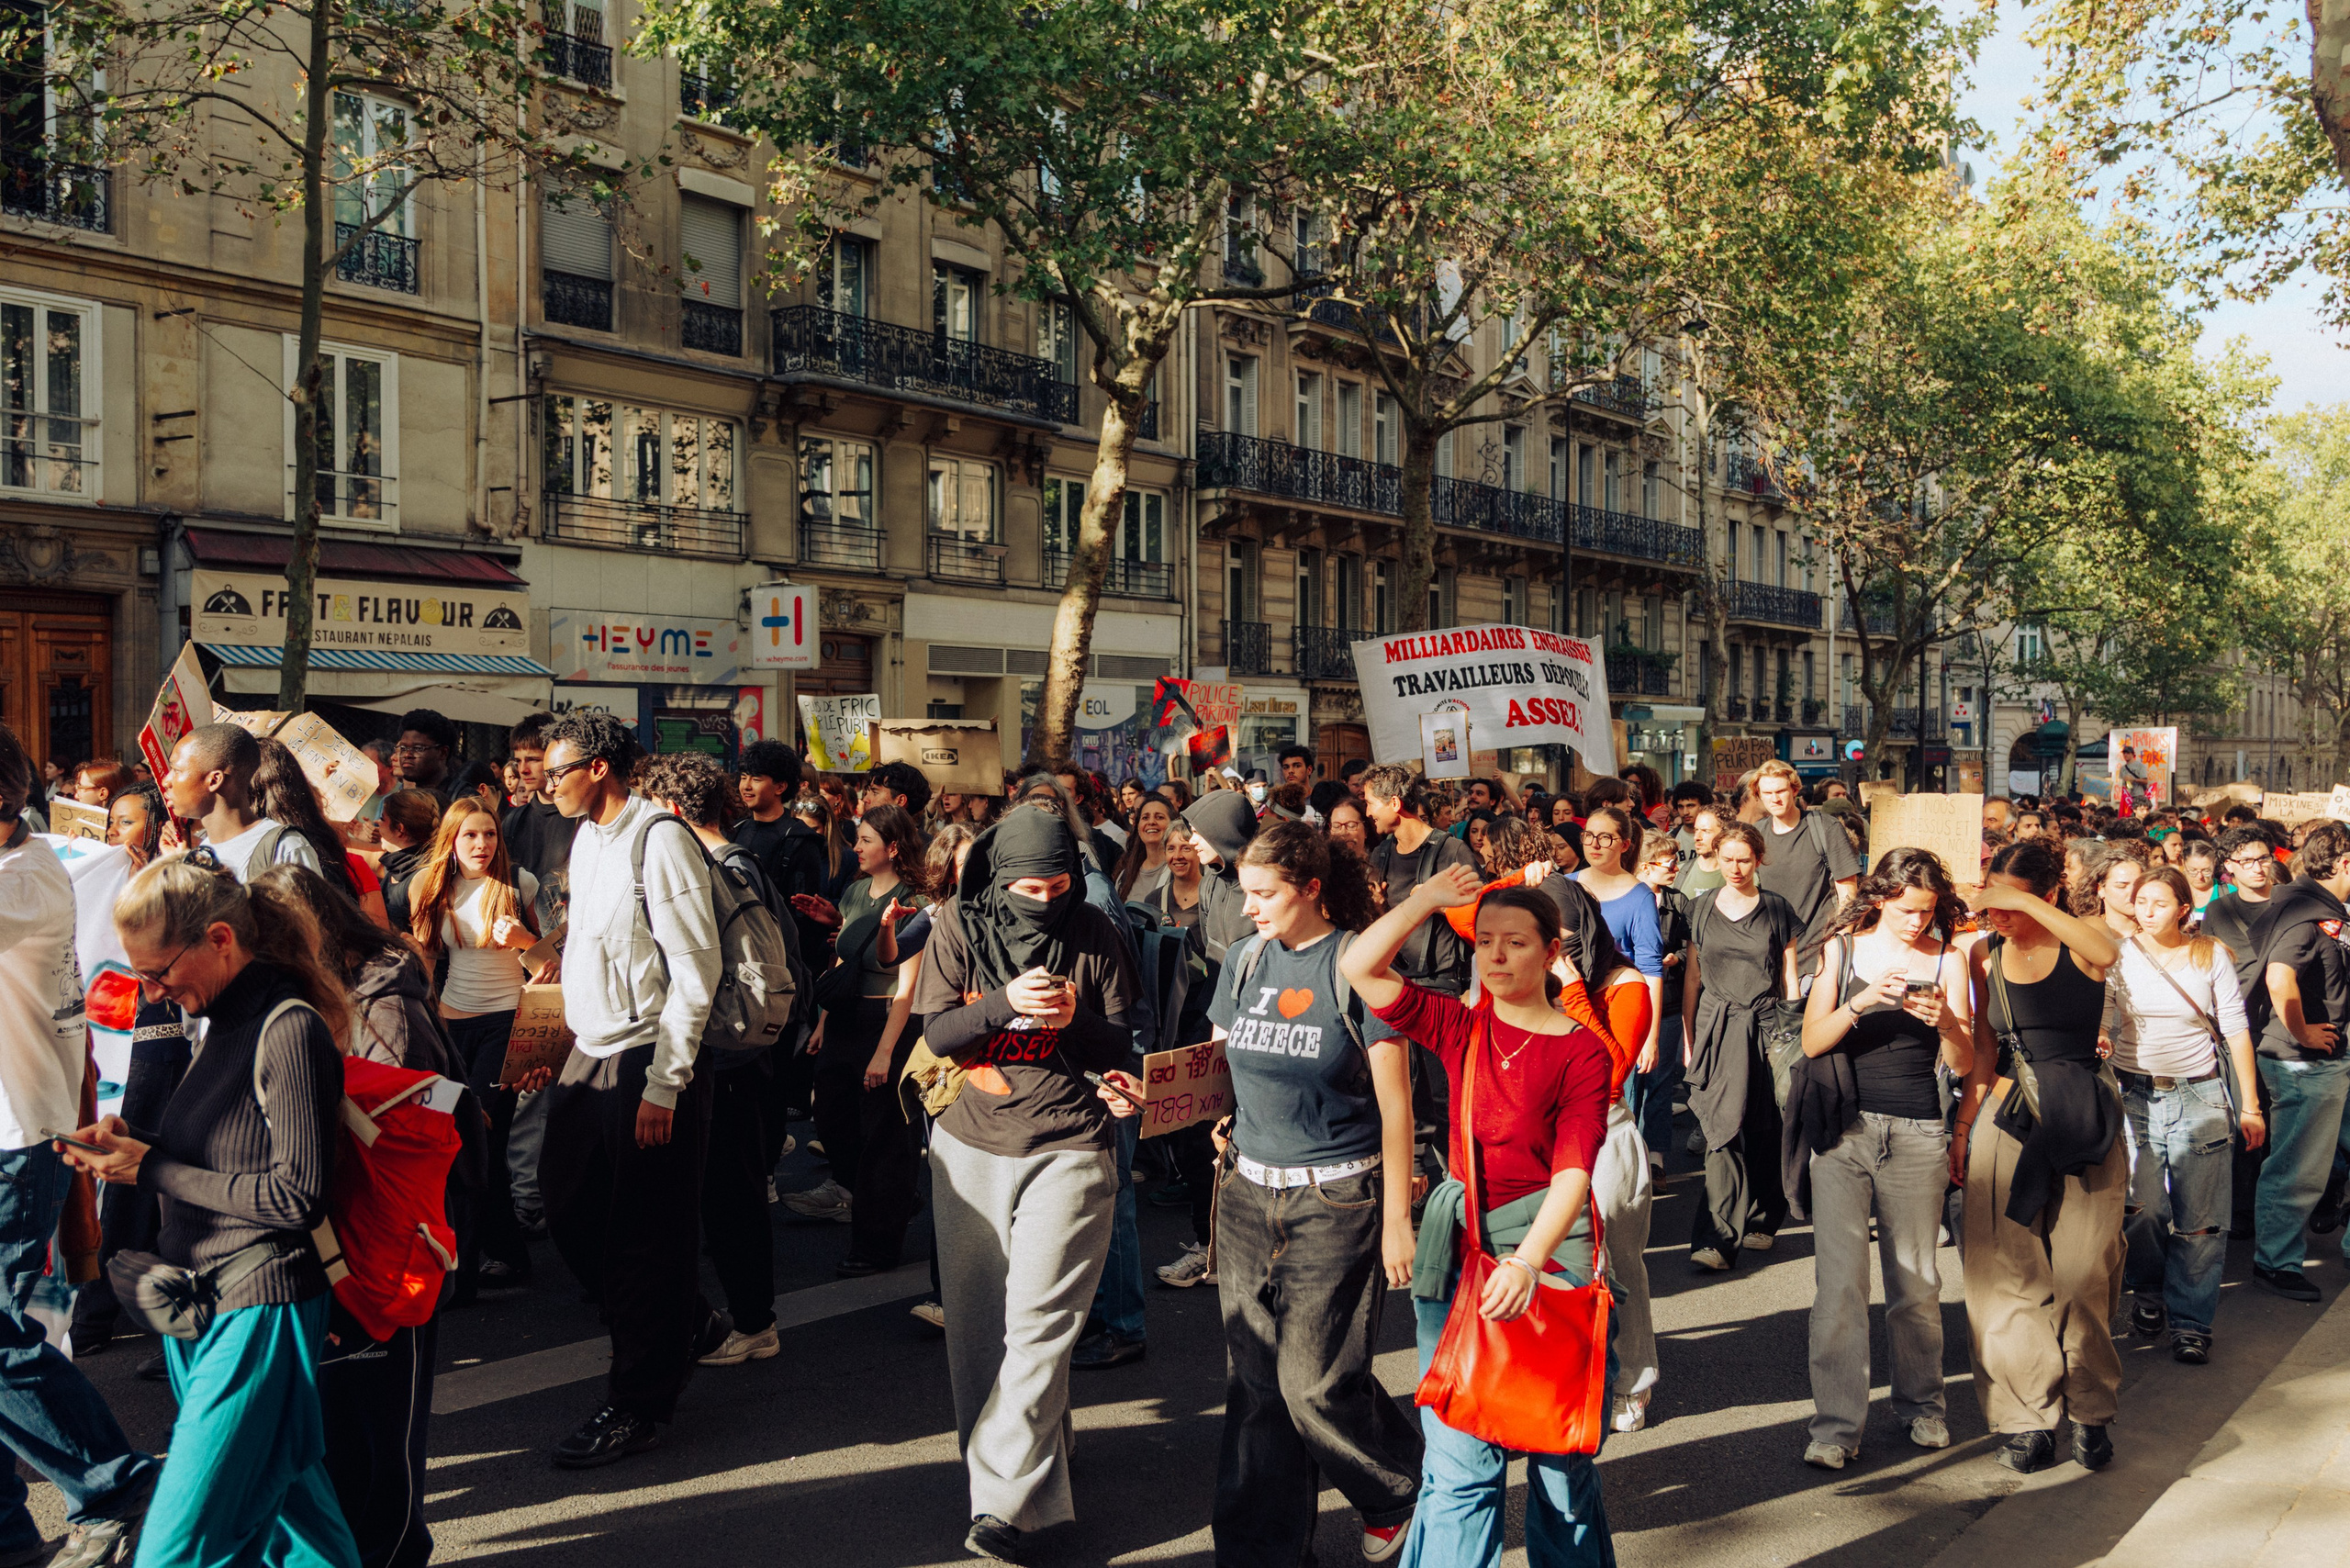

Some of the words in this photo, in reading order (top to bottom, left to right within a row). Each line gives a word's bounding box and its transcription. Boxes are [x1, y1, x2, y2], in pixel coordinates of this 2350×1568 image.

[312, 630, 375, 644] STAURANT
[377, 631, 432, 647] NÉPALAIS
[582, 624, 713, 657] HEYME
[1383, 627, 1526, 664] MILLIARDAIRES
[1529, 629, 1594, 666] ENGRAISSÉS
[607, 661, 650, 673] l'assurance
[651, 663, 664, 672] des
[665, 664, 689, 674] jeunes
[1393, 662, 1535, 698] TRAVAILLEURS
[1189, 683, 1237, 704] POLICE
[822, 700, 835, 712] DE
[839, 698, 876, 717] FRIC
[1086, 700, 1111, 715] EOL
[1244, 696, 1267, 712] Laser
[824, 714, 836, 731] LE
[1195, 704, 1240, 724] PARTOUT
[297, 713, 327, 741] LES
[323, 734, 365, 771] JEUNES
[1751, 738, 1774, 754] PAS
[286, 734, 329, 770] VEULENT
[330, 769, 350, 790] UN
[924, 752, 956, 761] IKEA
[1715, 752, 1748, 769] PEUR
[1924, 799, 1956, 815] NOUS
[2268, 797, 2313, 810] MISKINE
[2279, 808, 2294, 817] LA
[1910, 817, 1952, 836] DESSUS
[1955, 820, 1971, 836] ET
[1947, 837, 1977, 855] NOUS
[1248, 986, 1279, 1016] I
[530, 1007, 562, 1020] DES
[540, 1041, 557, 1053] LA
[1227, 1016, 1323, 1059] GREECE
[1186, 1042, 1215, 1062] APL
[1148, 1063, 1177, 1084] DES
[1185, 1059, 1209, 1080] GEL
[1146, 1092, 1193, 1125] BBL
[1198, 1092, 1225, 1114] AUX
